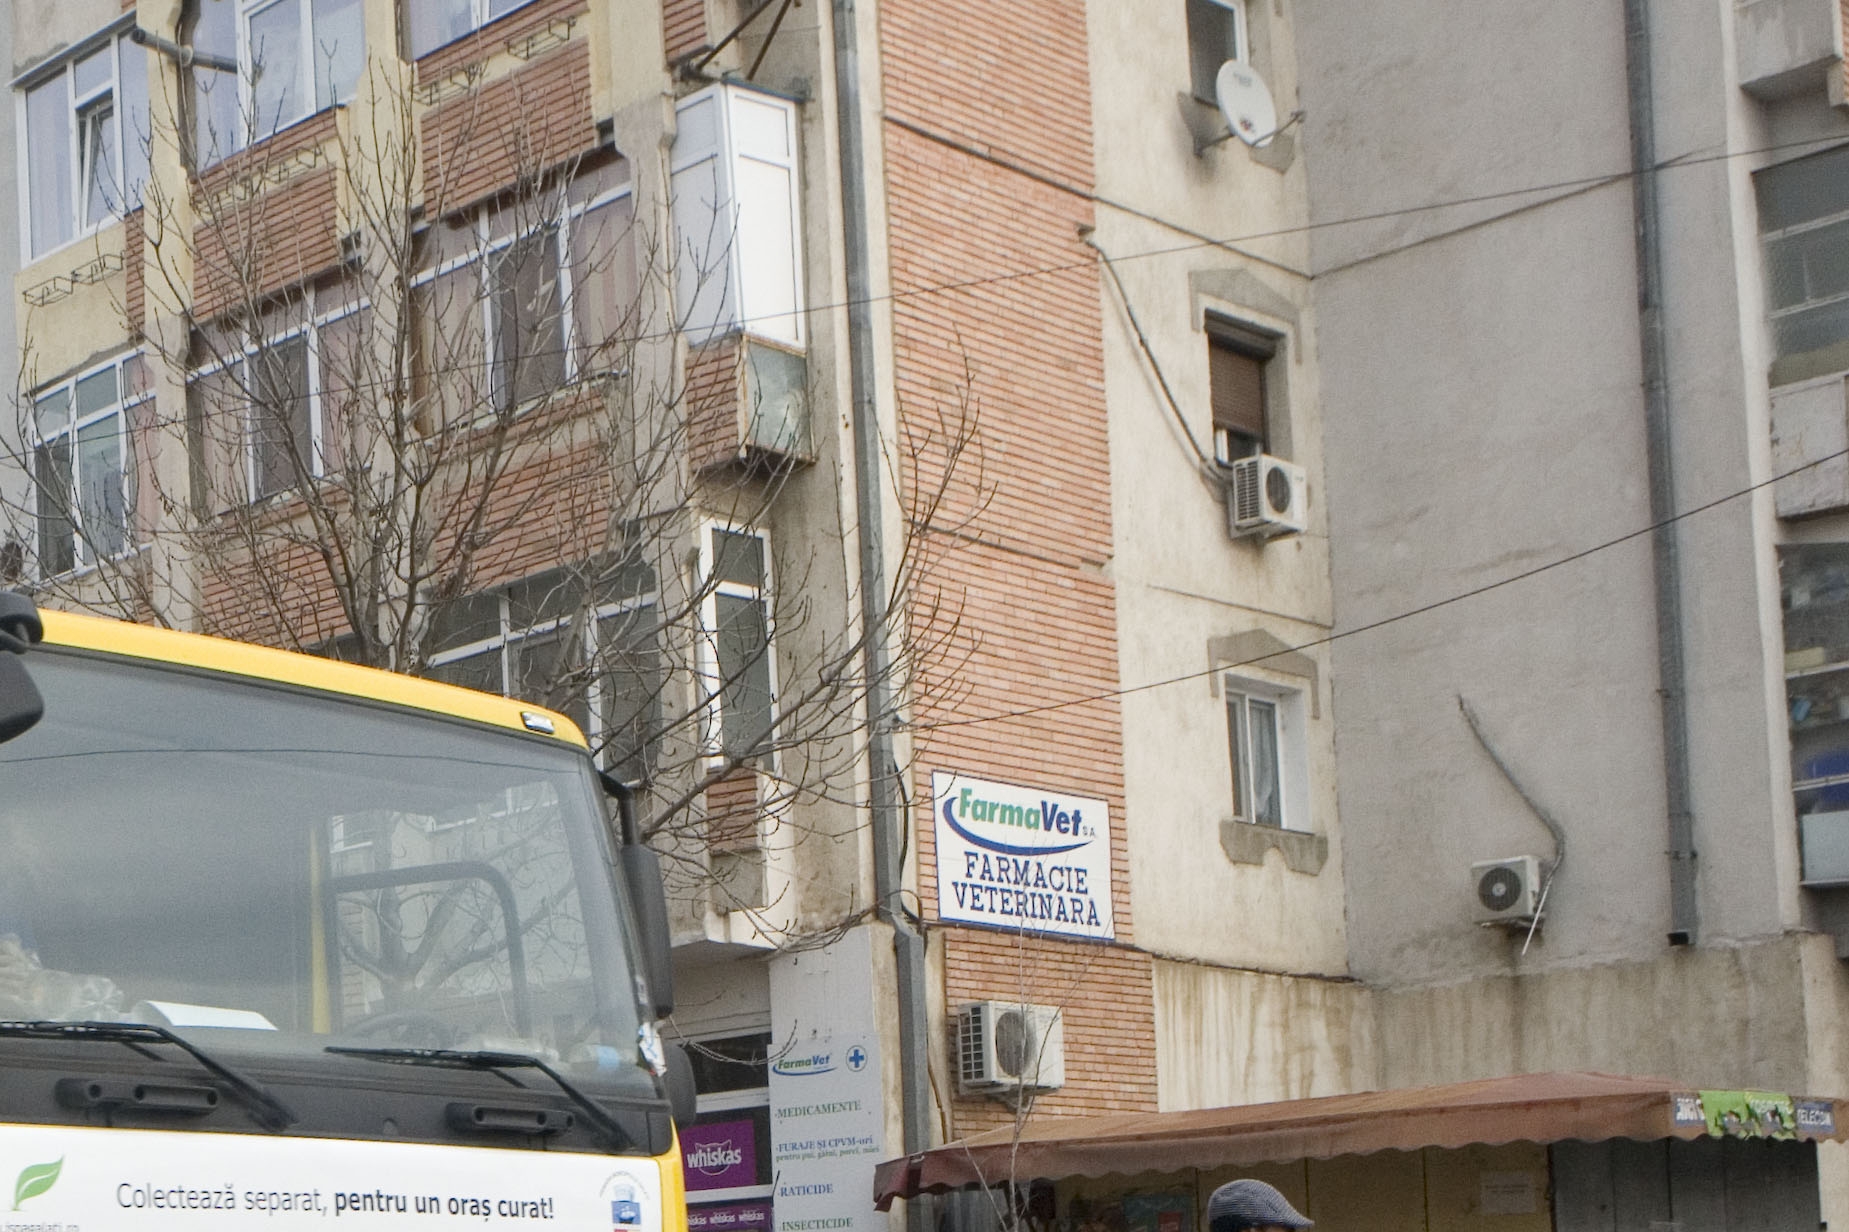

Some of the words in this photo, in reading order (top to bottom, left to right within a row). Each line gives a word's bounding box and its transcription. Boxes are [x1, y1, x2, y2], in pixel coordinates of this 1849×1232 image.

[959, 787, 1082, 836] FarmaVet
[964, 851, 1088, 895] FARMACIE
[952, 881, 1101, 927] VETERINARA
[778, 1055, 830, 1070] FarmaVet
[687, 1147, 742, 1168] whiskas
[117, 1183, 236, 1209] Colectează
[245, 1188, 327, 1216] separat,
[335, 1189, 407, 1217] pentru
[415, 1195, 441, 1215] un
[448, 1197, 491, 1222] oraș
[498, 1197, 554, 1220] curat!
[782, 1217, 853, 1231] INSECTICIDE
